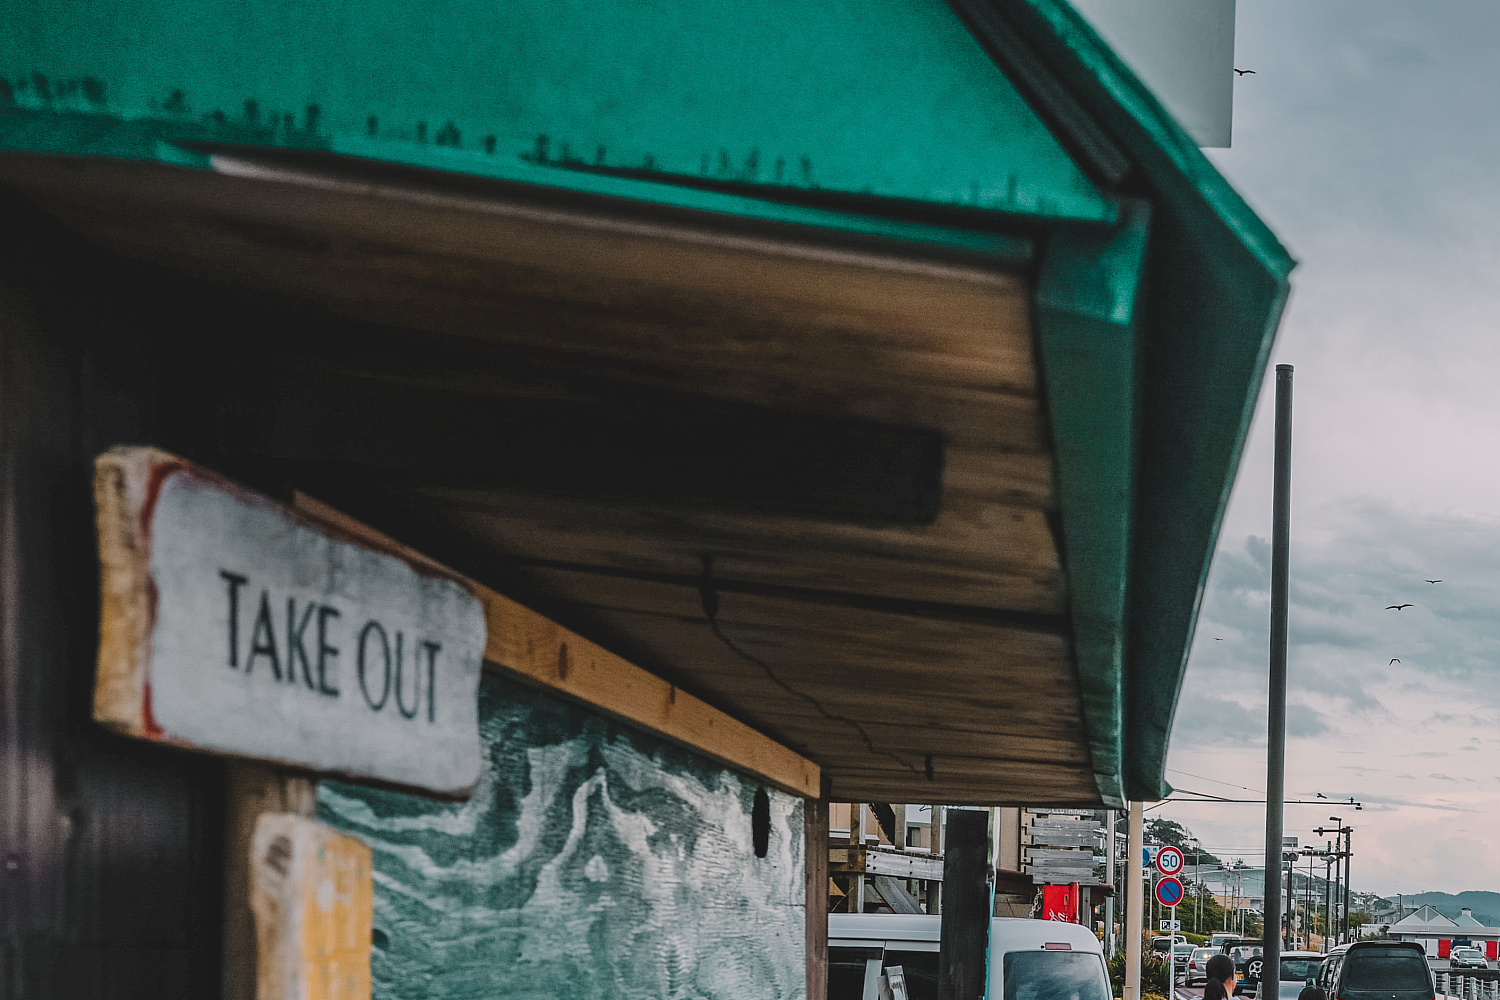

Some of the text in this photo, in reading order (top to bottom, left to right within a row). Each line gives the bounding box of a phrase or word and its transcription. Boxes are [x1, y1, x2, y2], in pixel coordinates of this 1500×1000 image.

[218, 568, 443, 723] TAKE OUT
[1162, 854, 1178, 868] 50
